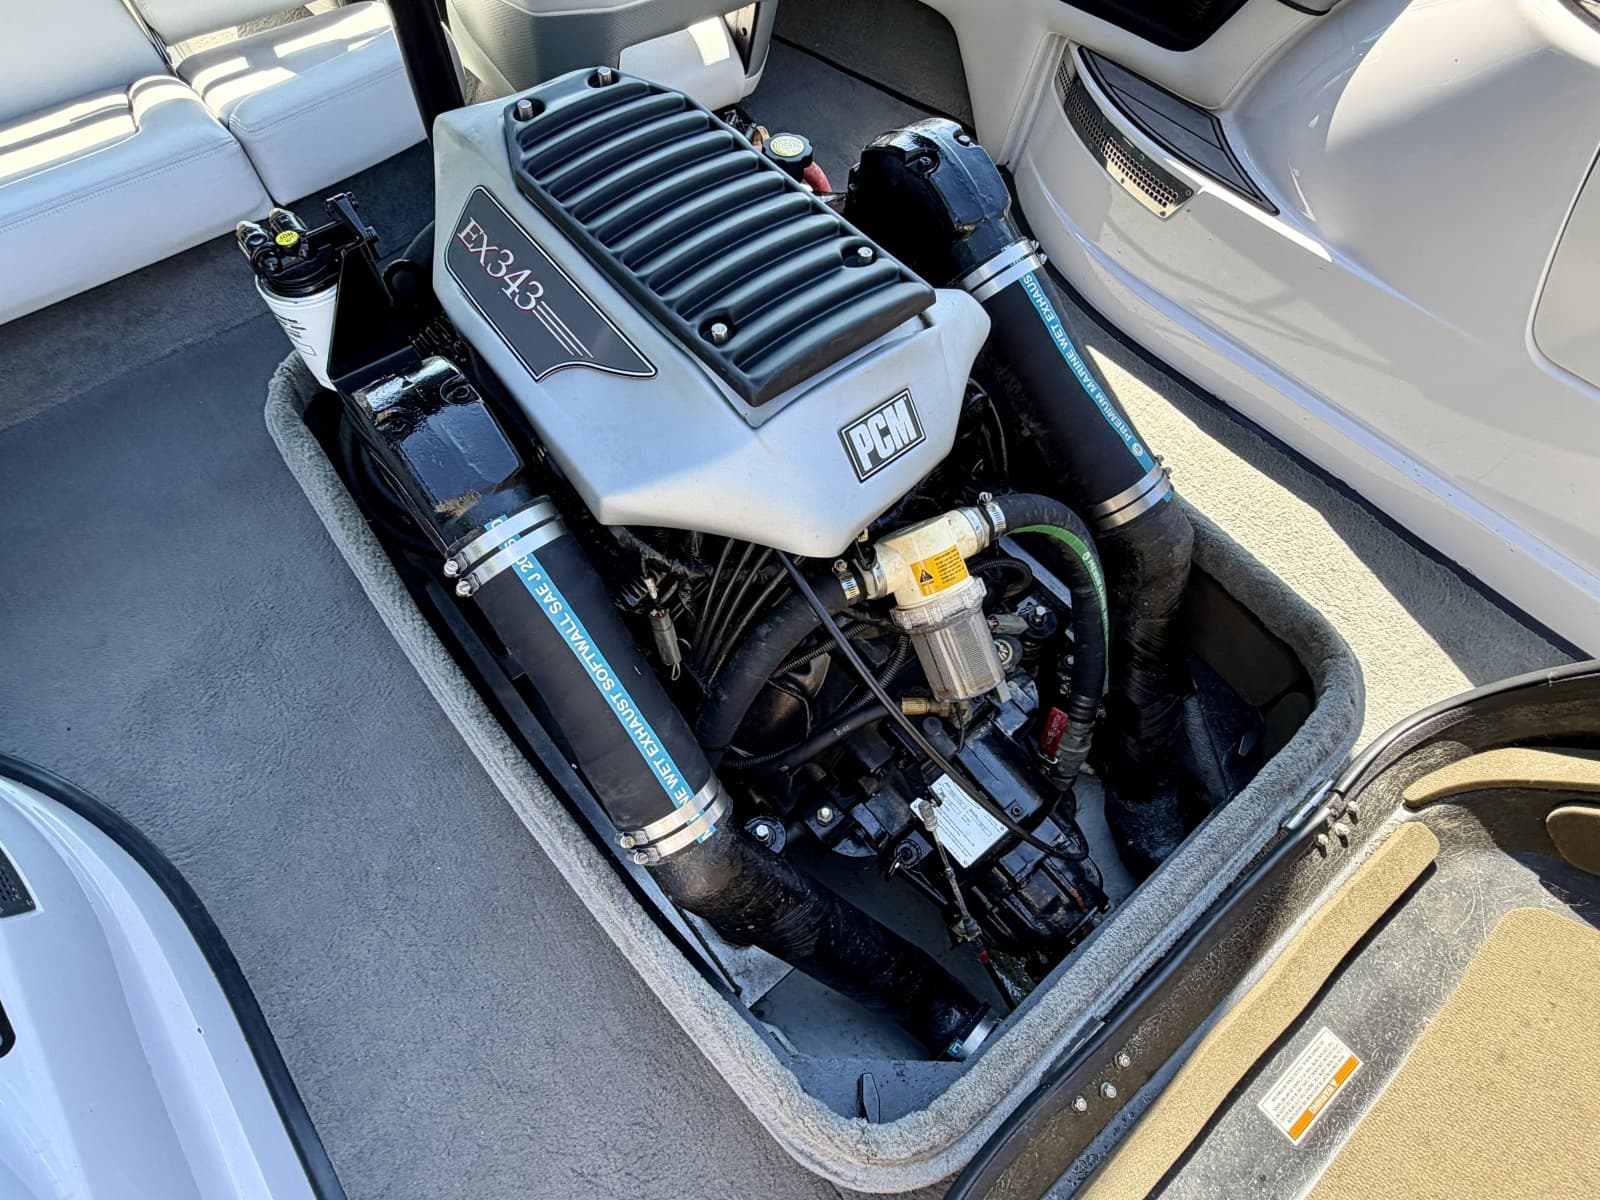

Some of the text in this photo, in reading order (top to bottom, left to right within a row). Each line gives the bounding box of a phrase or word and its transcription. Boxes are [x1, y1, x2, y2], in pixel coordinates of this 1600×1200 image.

[457, 217, 544, 311] EX343
[1024, 274, 1132, 441] PREMIUM MARINE WET EXHAUS
[849, 398, 917, 472] PCM
[527, 572, 542, 581] J
[535, 582, 563, 614] SAE
[560, 612, 615, 691] SOFTWALL
[609, 692, 659, 756] EXHAUST
[653, 759, 679, 789] WET
